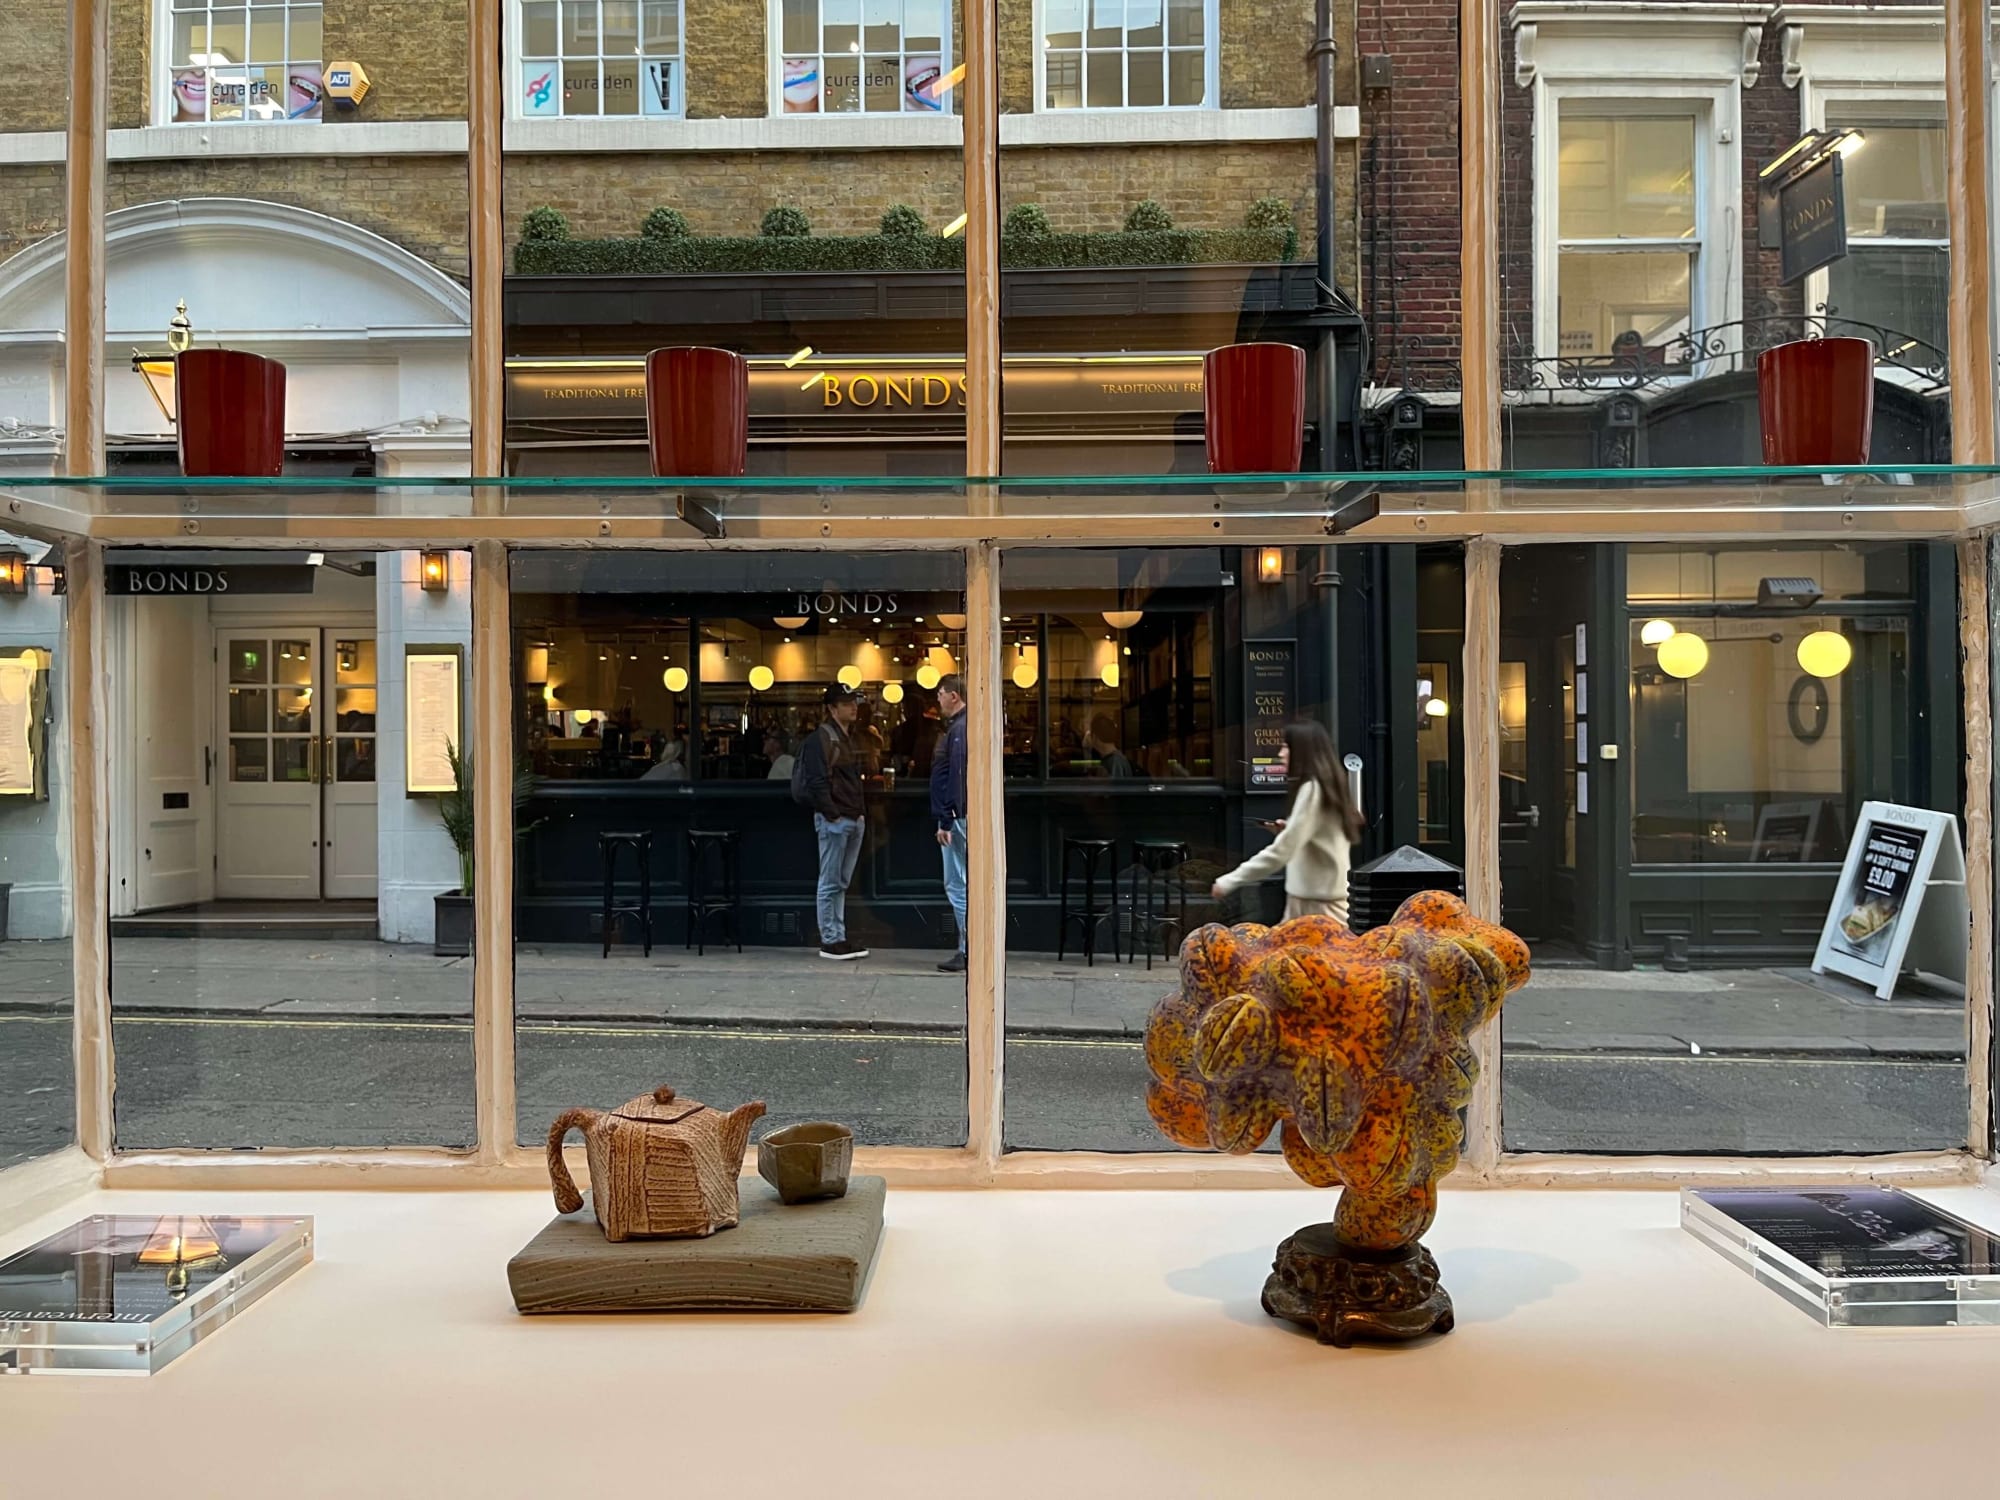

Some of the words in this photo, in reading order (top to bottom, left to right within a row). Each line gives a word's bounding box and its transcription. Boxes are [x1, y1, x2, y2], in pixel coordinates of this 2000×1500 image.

[330, 73, 352, 85] ADT
[564, 75, 633, 90] curaden
[825, 72, 894, 87] curaden
[212, 81, 278, 96] curaden
[543, 388, 620, 399] TRADITIONAL
[624, 388, 645, 398] FRE
[822, 373, 966, 407] BONDS
[1101, 383, 1180, 394] TRADITIONAL
[1184, 382, 1203, 393] FRE
[129, 571, 228, 592] BONDS
[797, 593, 898, 614] BONDS
[1249, 650, 1290, 661] BONDS
[1255, 696, 1284, 706] CASK
[1258, 706, 1283, 716] ALES
[0, 1310, 153, 1323] Interweavin
